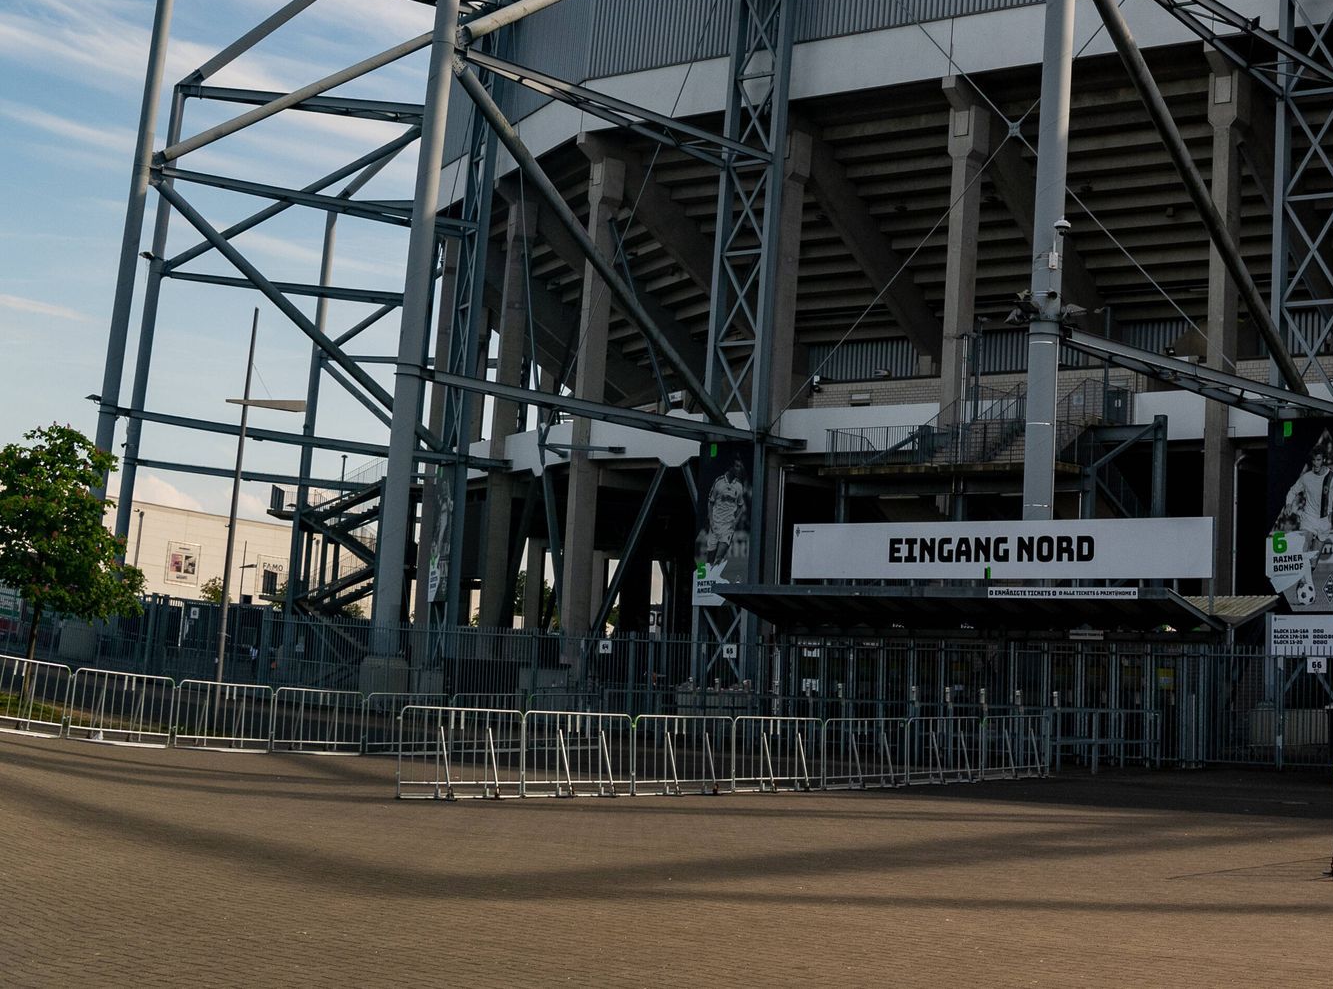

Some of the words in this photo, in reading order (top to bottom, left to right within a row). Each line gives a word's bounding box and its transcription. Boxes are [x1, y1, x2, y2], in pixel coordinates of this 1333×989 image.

[1272, 531, 1288, 553] 6
[888, 536, 1010, 563] EINGANG
[1016, 535, 1095, 562] NORD
[1273, 554, 1303, 563] RAINER
[263, 562, 283, 571] FAMO
[697, 562, 706, 579] 5
[1273, 563, 1304, 572] BONHOF
